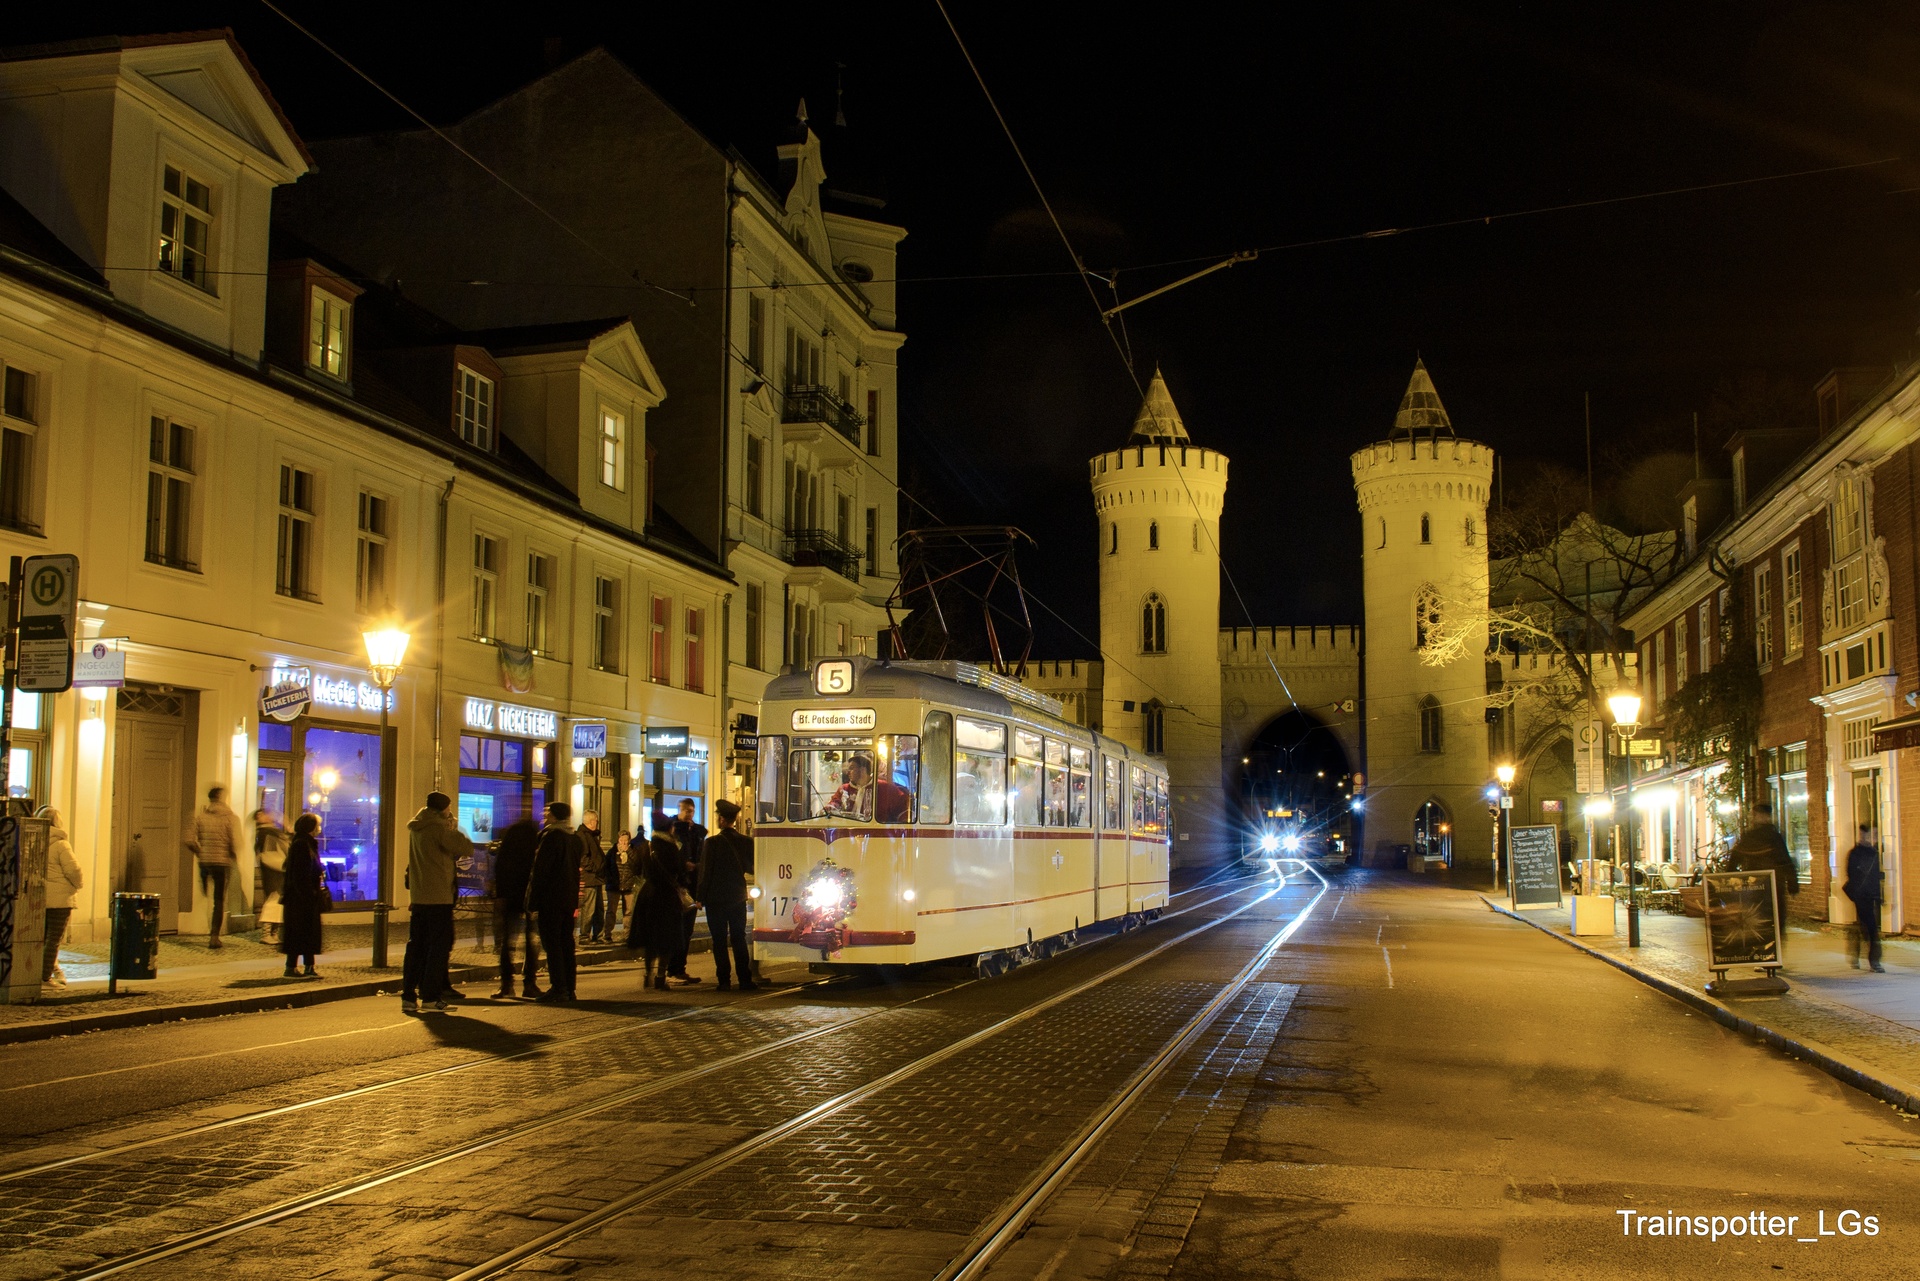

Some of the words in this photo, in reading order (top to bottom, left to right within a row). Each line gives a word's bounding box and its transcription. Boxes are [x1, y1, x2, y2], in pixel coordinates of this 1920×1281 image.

[40, 575, 56, 597] H
[829, 669, 844, 690] 5
[266, 690, 308, 710] TICKETERIA
[314, 676, 357, 705] Media
[359, 682, 393, 710] Stoe
[466, 700, 493, 730] MAZ
[498, 706, 557, 738] TICKETERIA
[812, 714, 872, 724] Potsdam-Stadt
